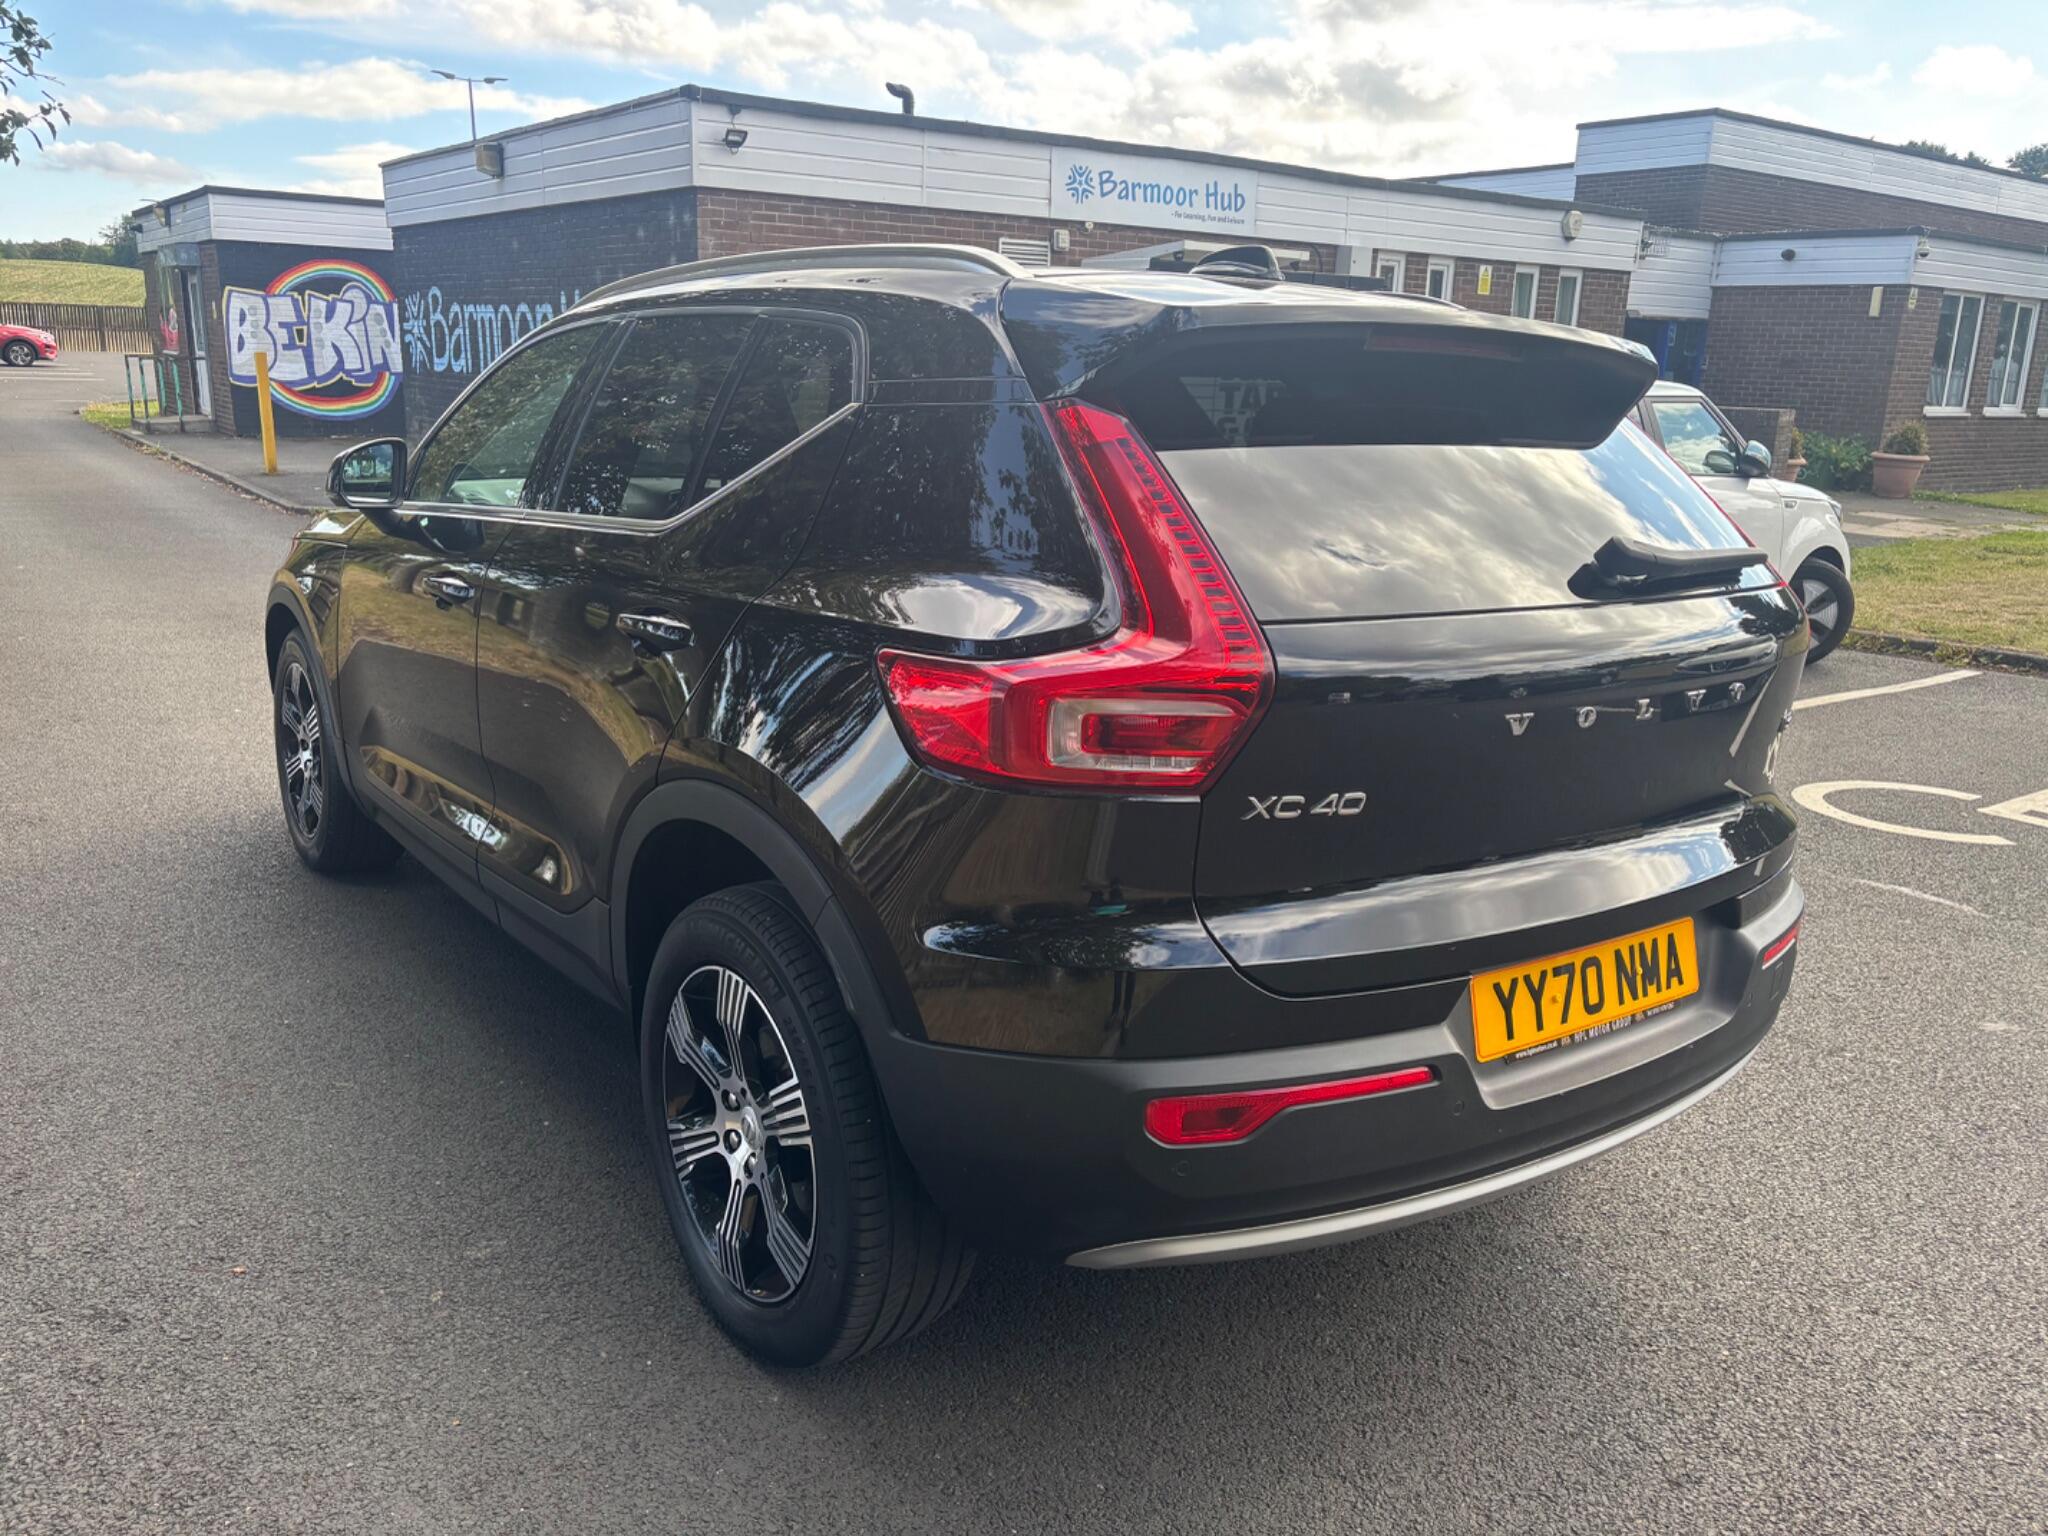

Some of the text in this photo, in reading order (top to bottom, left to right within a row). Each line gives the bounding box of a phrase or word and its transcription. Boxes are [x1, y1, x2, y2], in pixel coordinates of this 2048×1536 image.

[1098, 170, 1246, 213] Barmoor Hub
[1505, 681, 1746, 736] VOLVO
[1493, 933, 1684, 1041] YY70 NMA
